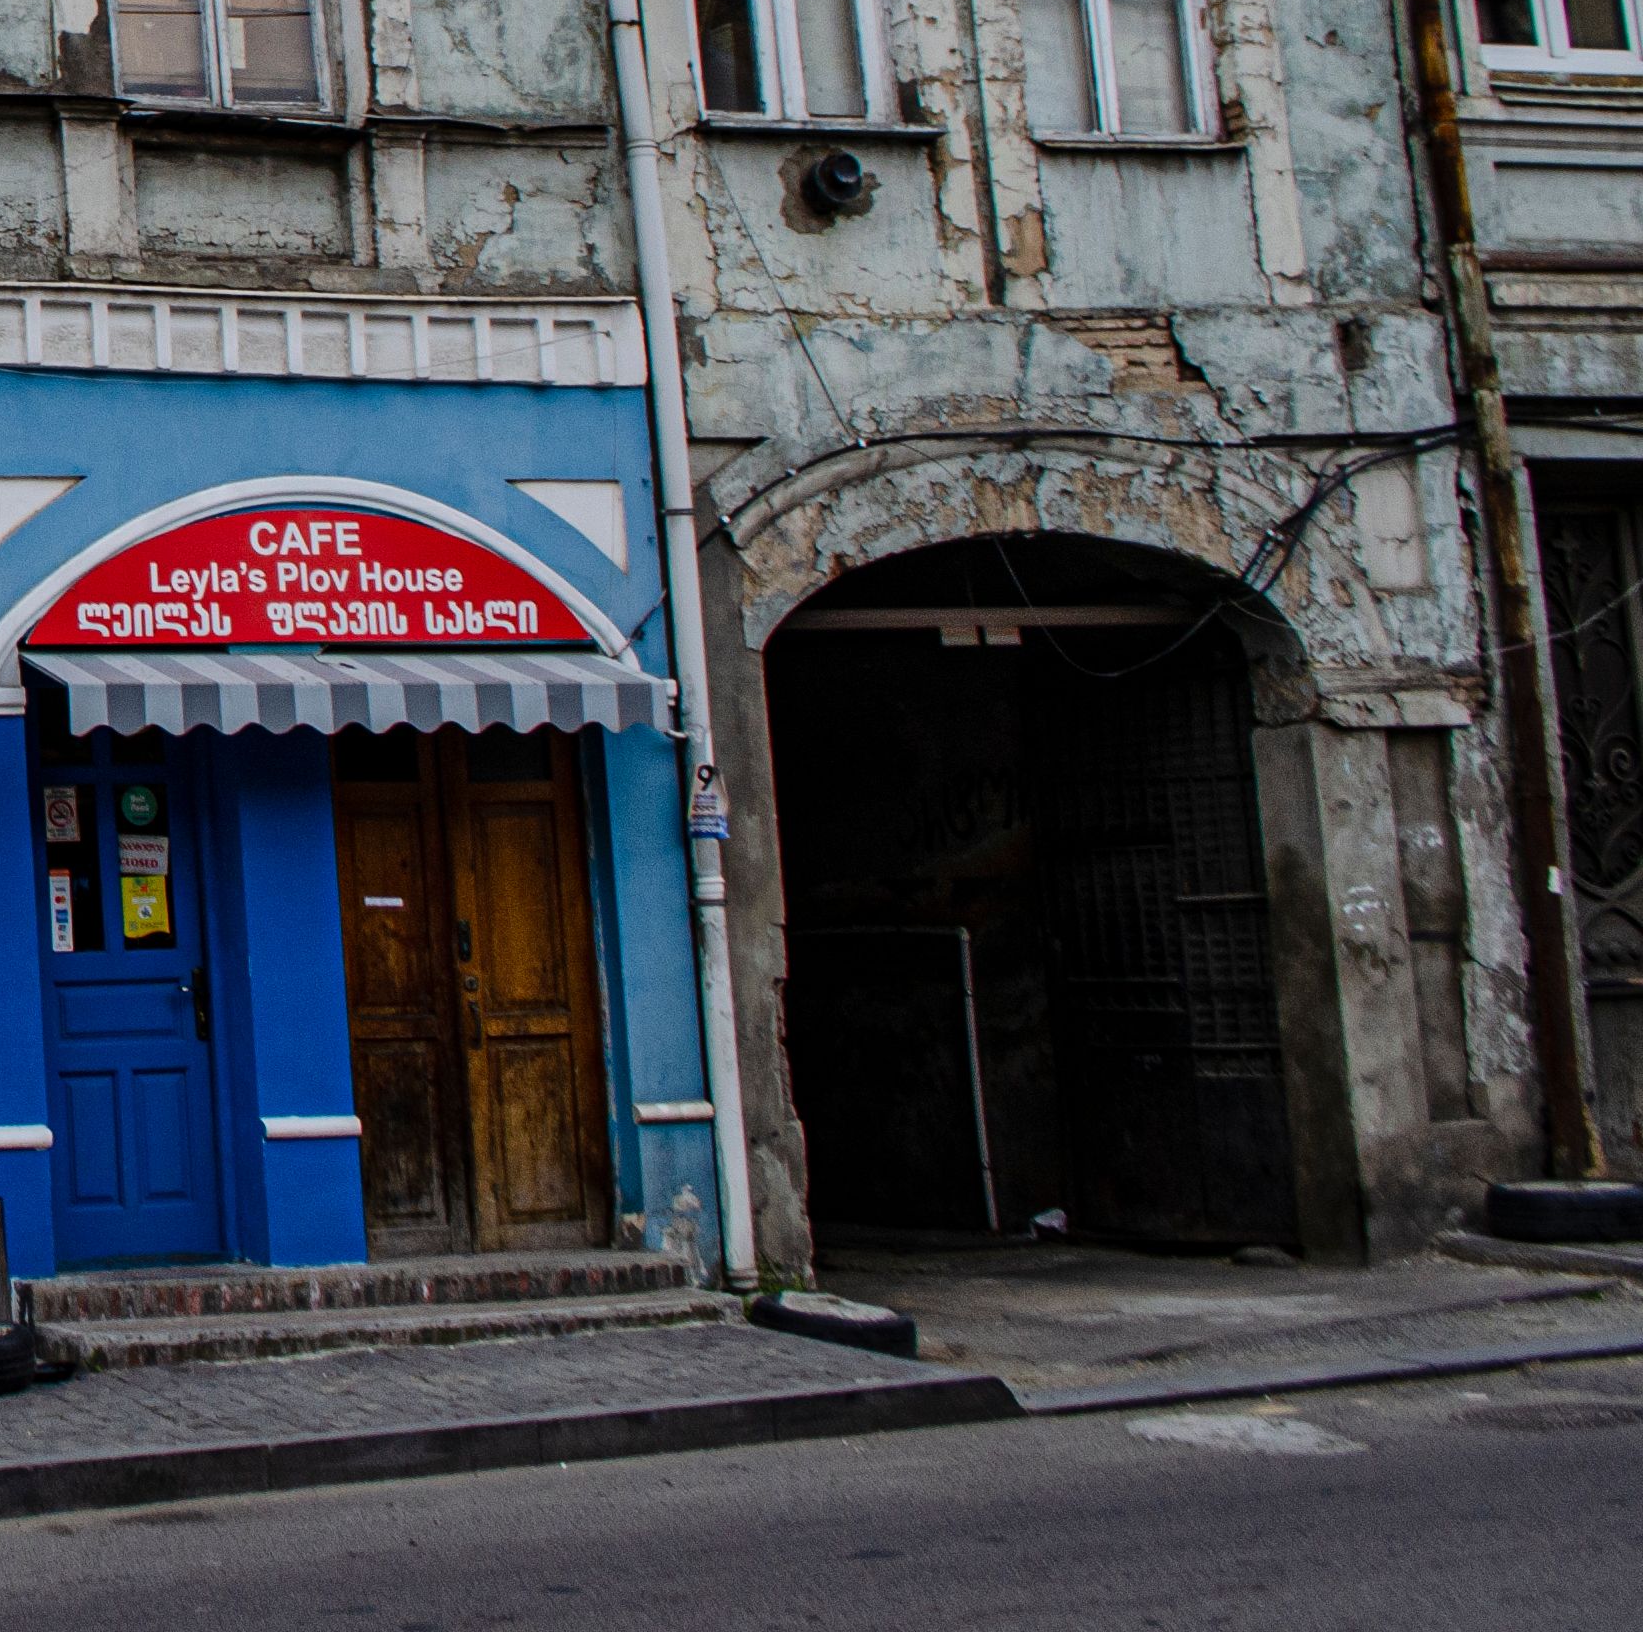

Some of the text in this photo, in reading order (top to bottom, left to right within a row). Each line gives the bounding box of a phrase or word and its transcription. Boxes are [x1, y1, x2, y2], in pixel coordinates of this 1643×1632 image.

[250, 521, 362, 556] CAFE
[278, 563, 350, 592] Plov
[359, 561, 464, 592] House
[77, 600, 539, 637] ლეილას ფლავის სახლი
